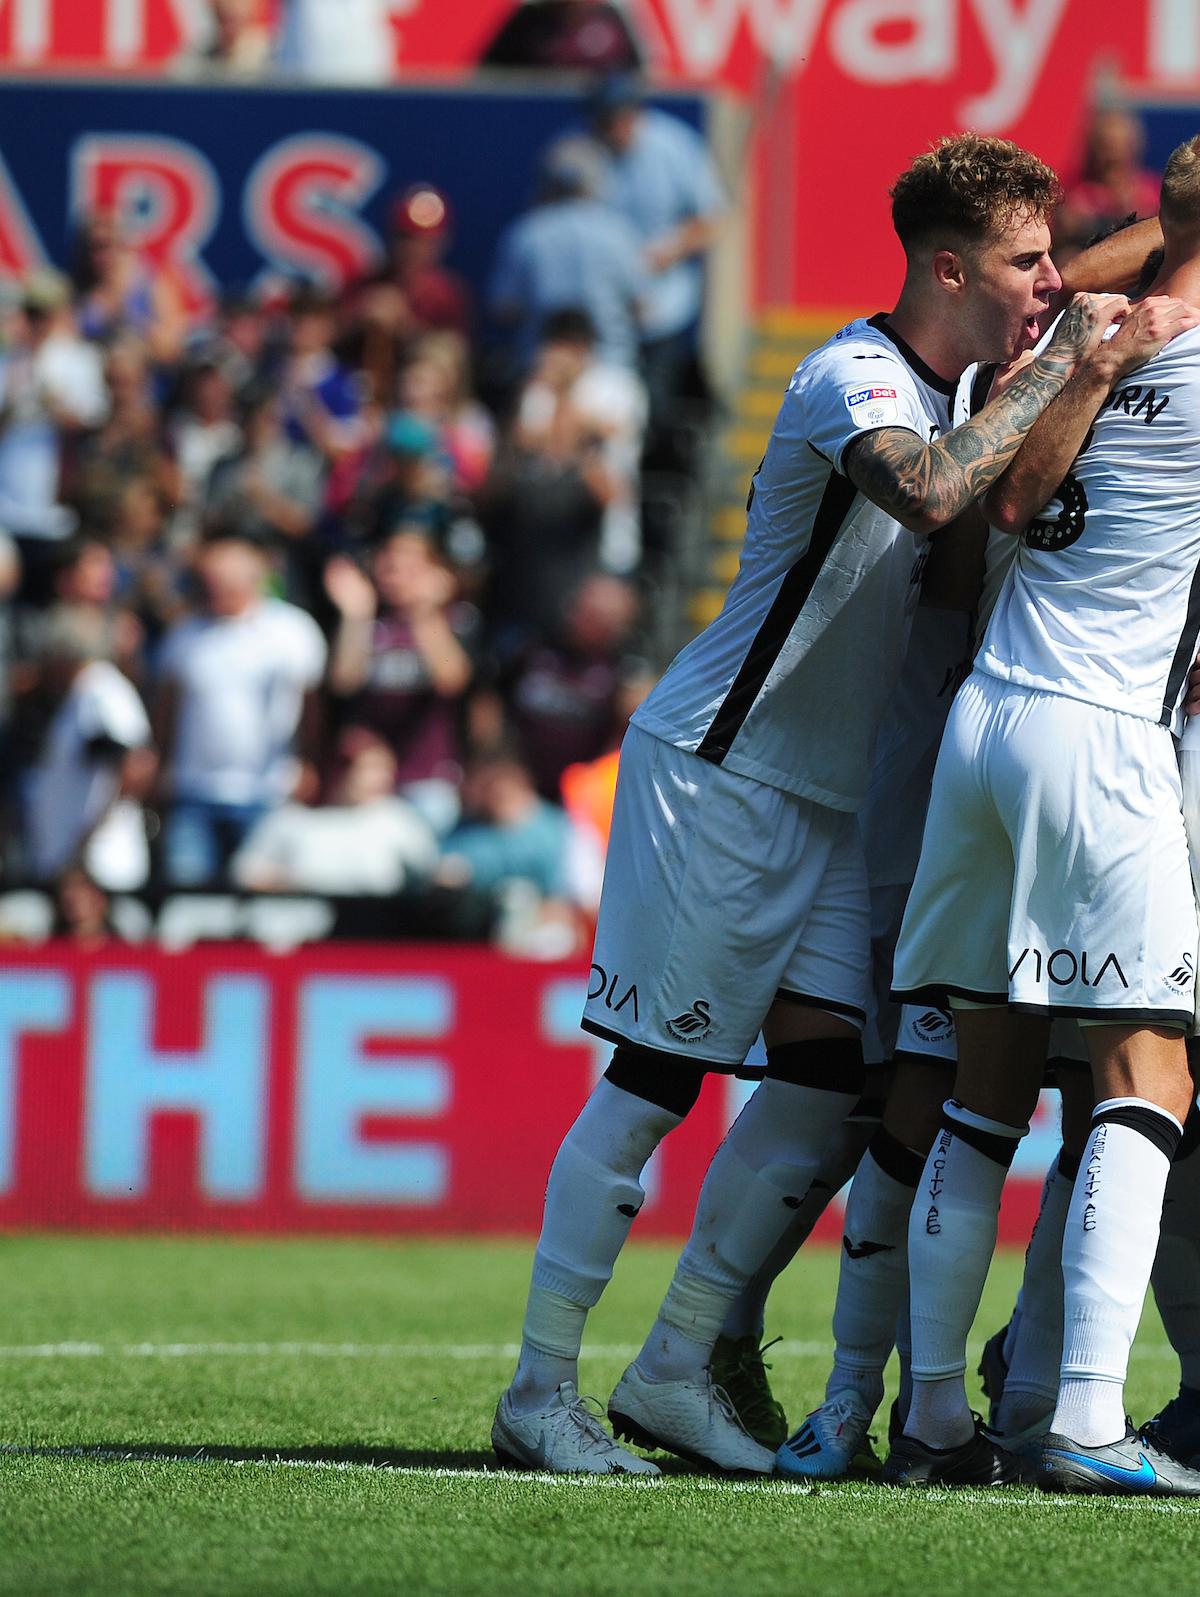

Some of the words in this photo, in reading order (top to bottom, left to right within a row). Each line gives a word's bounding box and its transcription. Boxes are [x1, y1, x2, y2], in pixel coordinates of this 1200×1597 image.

[849, 391, 870, 404] sky
[873, 389, 895, 397] bet
[929, 1160, 946, 1200] CITY
